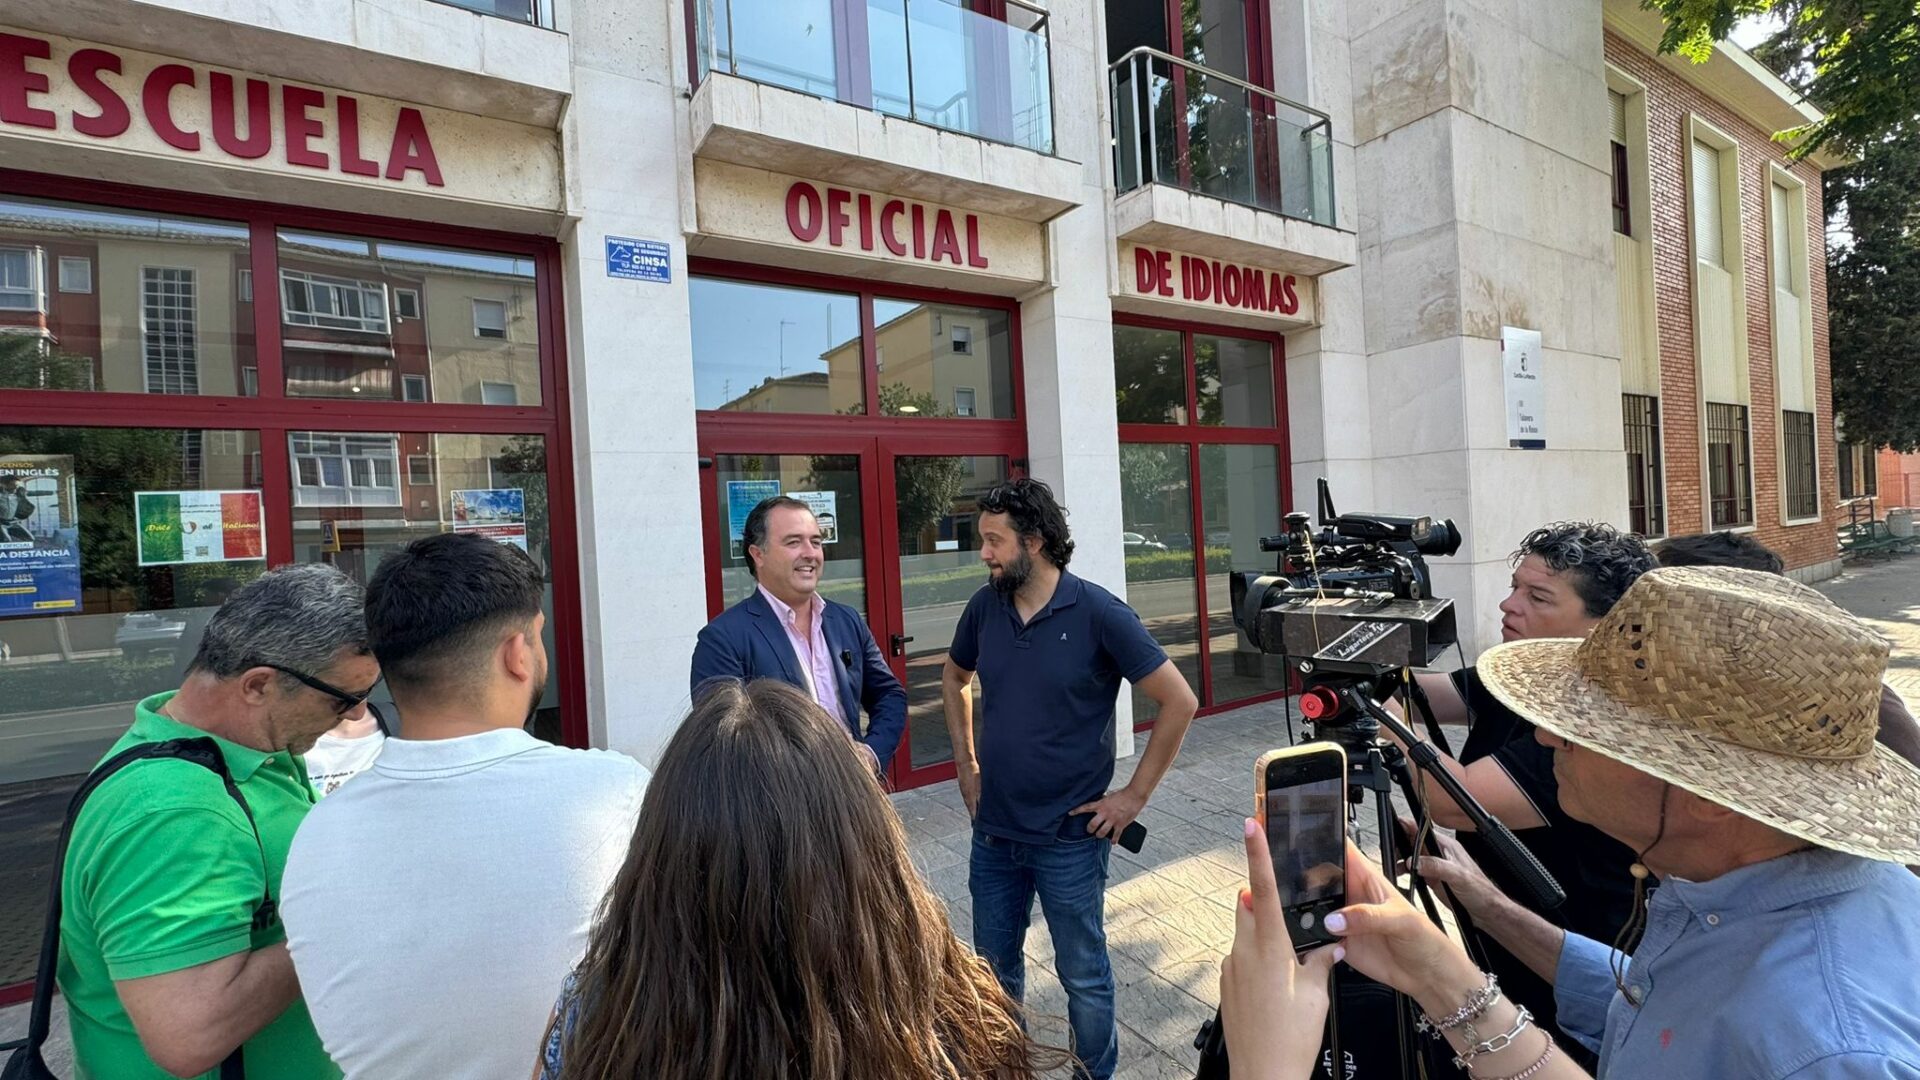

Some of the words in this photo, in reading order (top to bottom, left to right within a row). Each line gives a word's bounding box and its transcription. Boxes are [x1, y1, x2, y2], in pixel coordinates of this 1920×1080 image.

[0, 33, 445, 187] ESCUELA
[786, 181, 989, 269] OFICIAL
[632, 254, 667, 268] CINSA
[1135, 247, 1174, 297] DE
[1181, 255, 1299, 316] IDIOMAS
[16, 466, 60, 476] INGLÉS
[9, 548, 71, 558] DISTANCIA
[1337, 631, 1375, 657] Lagartera
